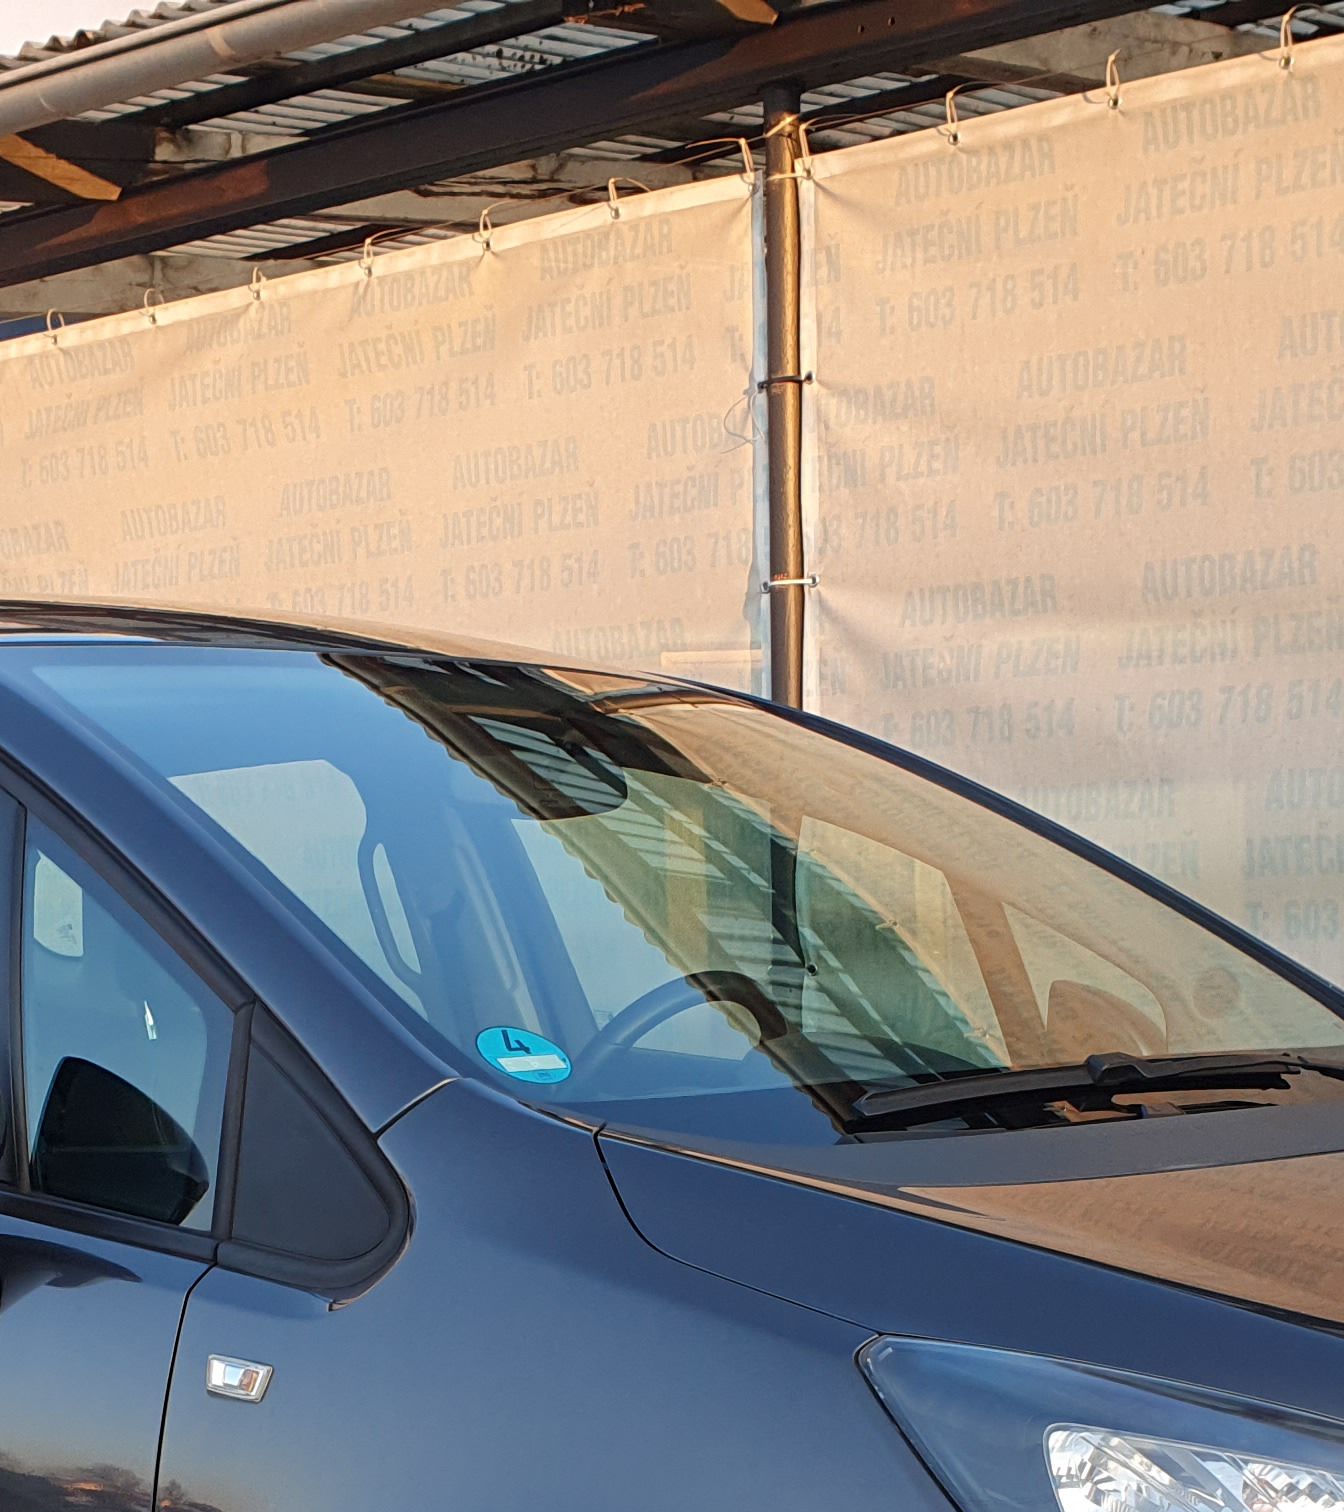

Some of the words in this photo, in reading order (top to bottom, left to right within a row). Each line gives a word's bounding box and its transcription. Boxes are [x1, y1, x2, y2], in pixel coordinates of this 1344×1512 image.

[1117, 147, 1240, 226] JATEČNÍ
[994, 181, 1077, 251] PLZEŇ
[1153, 237, 1207, 288] 603
[1221, 224, 1276, 275] 718
[622, 261, 691, 322] PLZEŇ
[875, 296, 896, 337] T:
[968, 273, 1017, 321] 718
[1029, 260, 1080, 309] 514
[433, 303, 497, 361] PLZEŇ
[601, 344, 642, 386] 718
[653, 333, 695, 377] 514
[250, 340, 309, 395] PLZEŇ
[458, 371, 496, 412] 514
[1017, 332, 1186, 400] AUTOBAZAR
[995, 399, 1109, 468] JATEČNÍ
[1121, 384, 1209, 450] PLZEŇ
[75, 443, 108, 478] 718
[453, 435, 579, 490] AUTOBAZAR
[1250, 456, 1274, 499] T:
[439, 491, 523, 548] JATEČNÍ
[533, 479, 598, 534] PLZEŇ
[853, 506, 899, 549] 718
[911, 498, 958, 542] 514
[994, 491, 1015, 531] T:
[1028, 482, 1078, 528] 603
[1091, 474, 1143, 520] 718
[1156, 464, 1209, 512] 514
[378, 573, 414, 611] 514
[512, 555, 551, 594] 718
[561, 548, 600, 588] 514
[1140, 542, 1318, 602] AUTOBAZAR
[901, 572, 1058, 627] AUTOBAZAR
[966, 703, 1014, 744] 718
[1025, 697, 1074, 740] 514
[1218, 682, 1272, 726] 718
[1286, 676, 1342, 721] 514
[501, 1030, 531, 1054] 4
